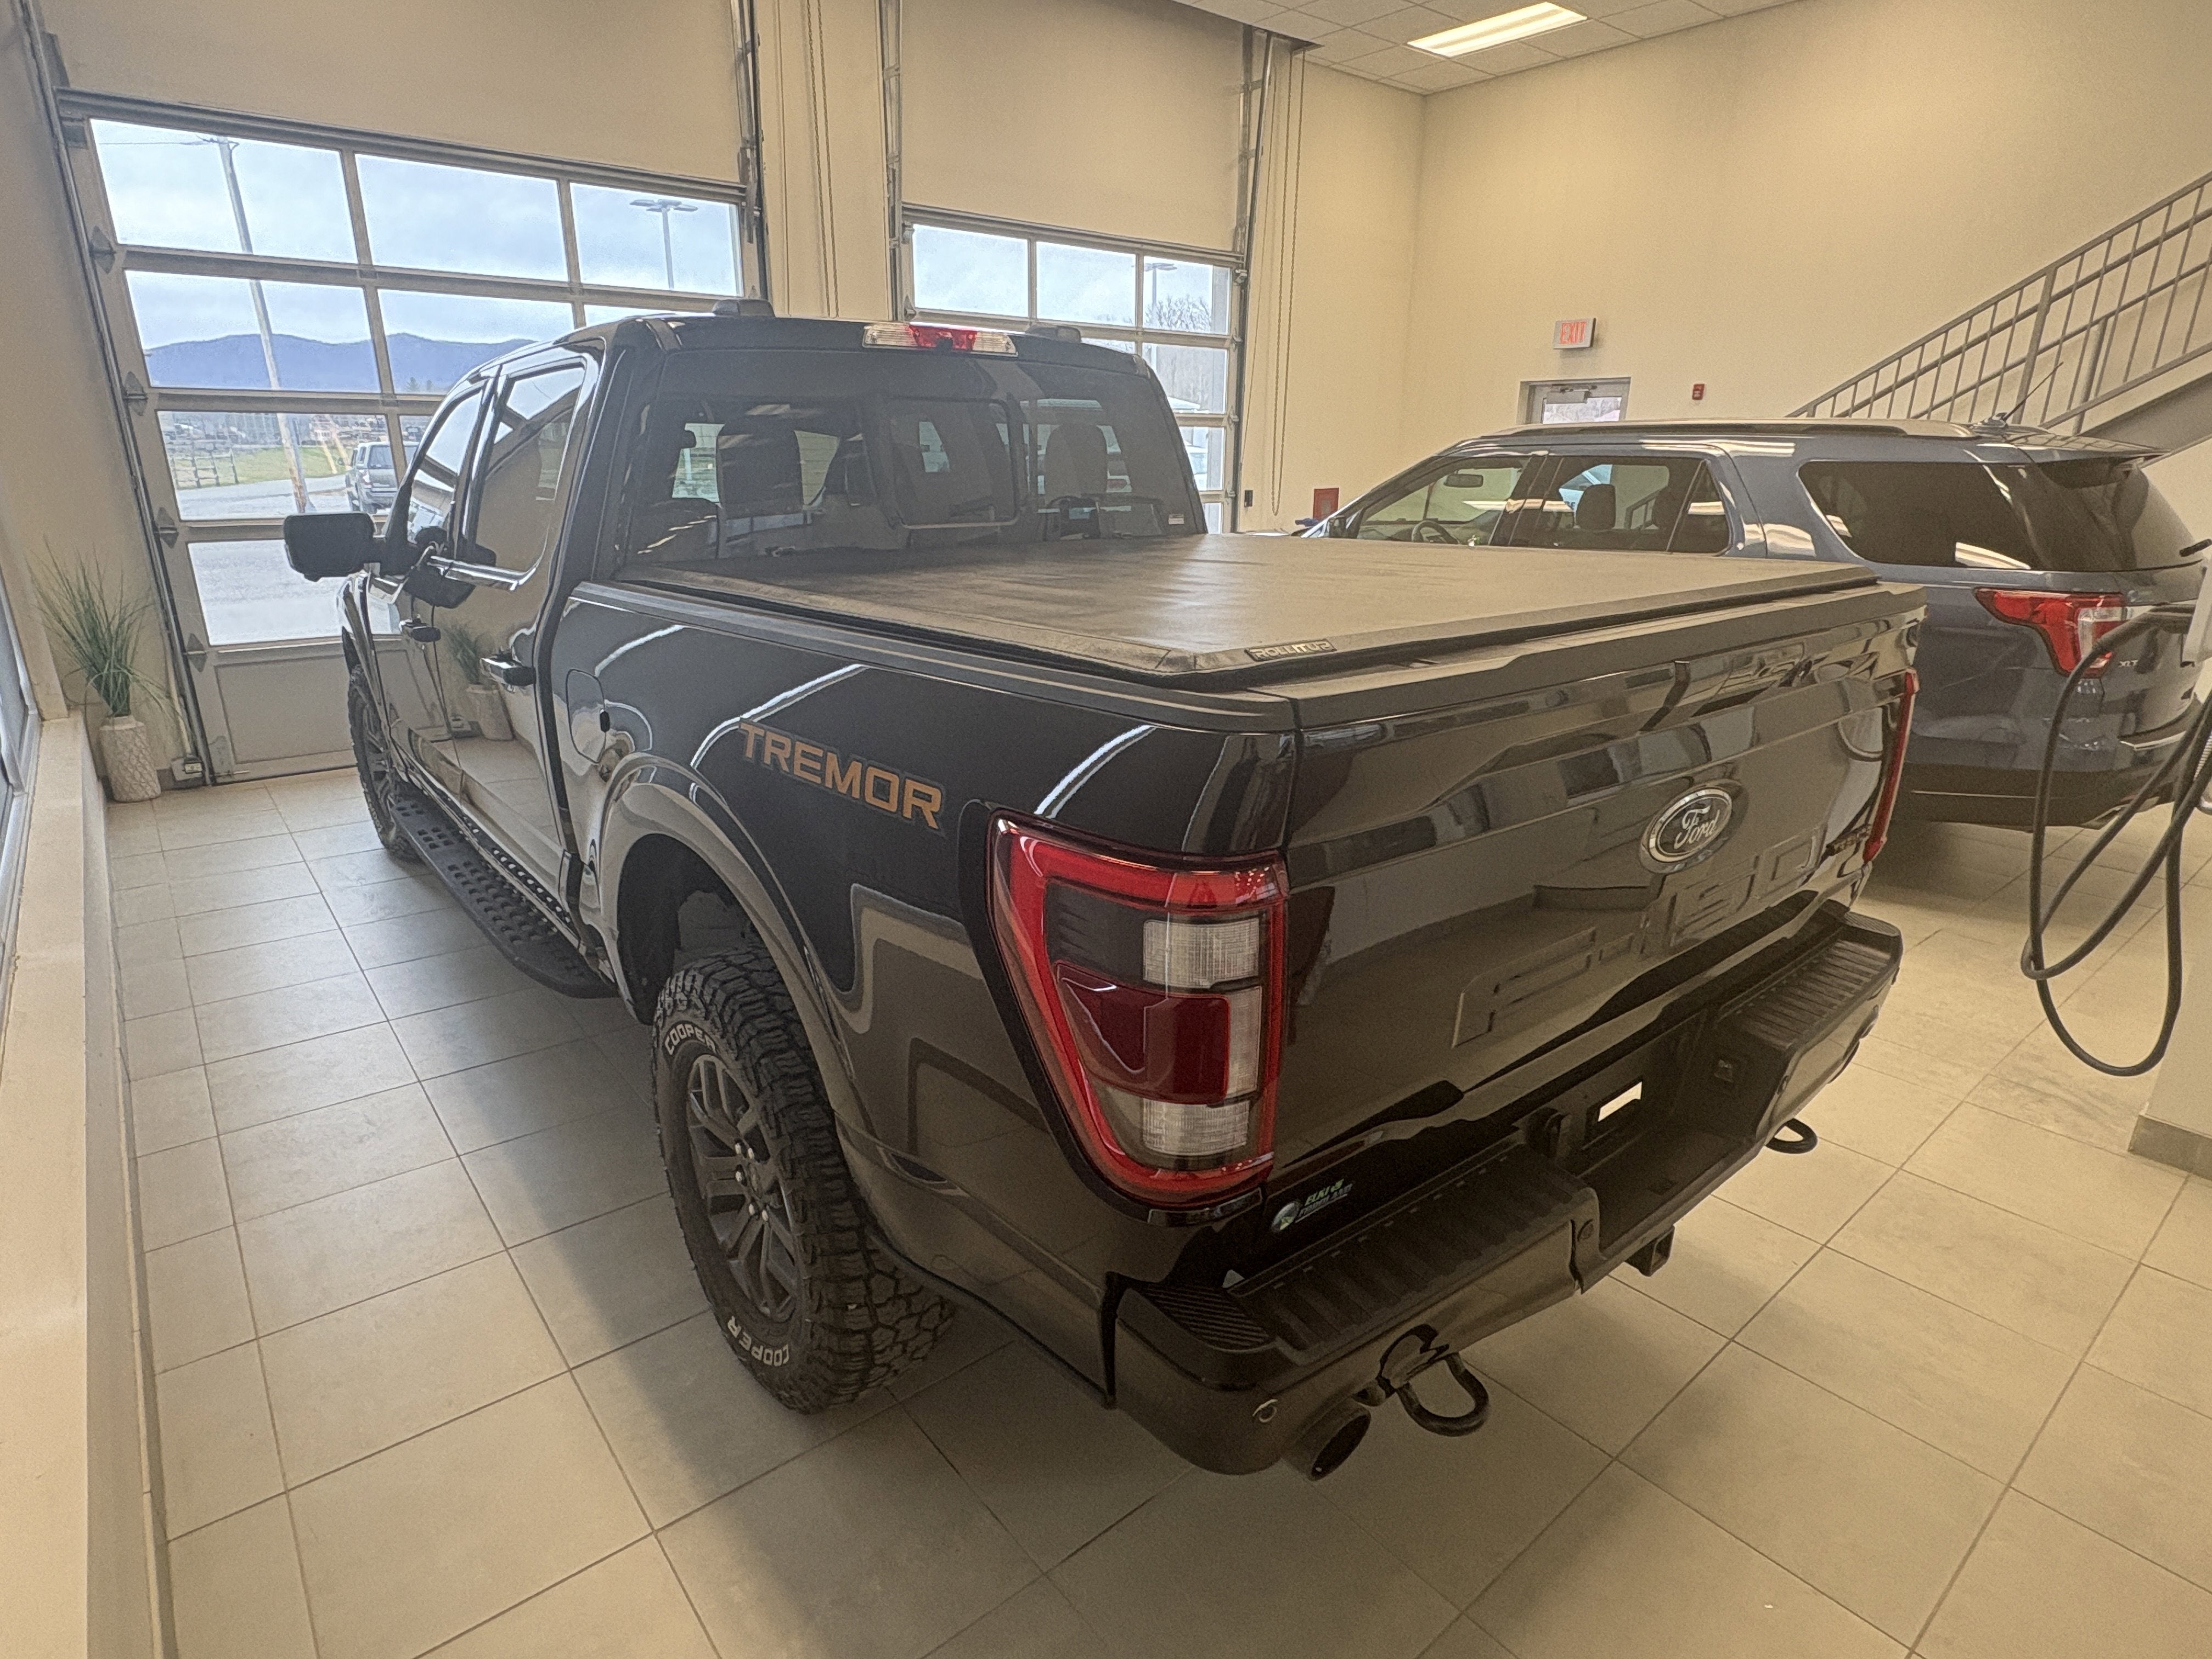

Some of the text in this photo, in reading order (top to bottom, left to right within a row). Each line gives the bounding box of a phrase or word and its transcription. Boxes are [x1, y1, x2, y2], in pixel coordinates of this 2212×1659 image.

[1560, 321, 1587, 344] EXIT
[740, 722, 942, 829] TREMOR
[1674, 805, 1720, 849] Ford
[665, 1024, 716, 1056] COOPER
[727, 1316, 789, 1367] COOPER
